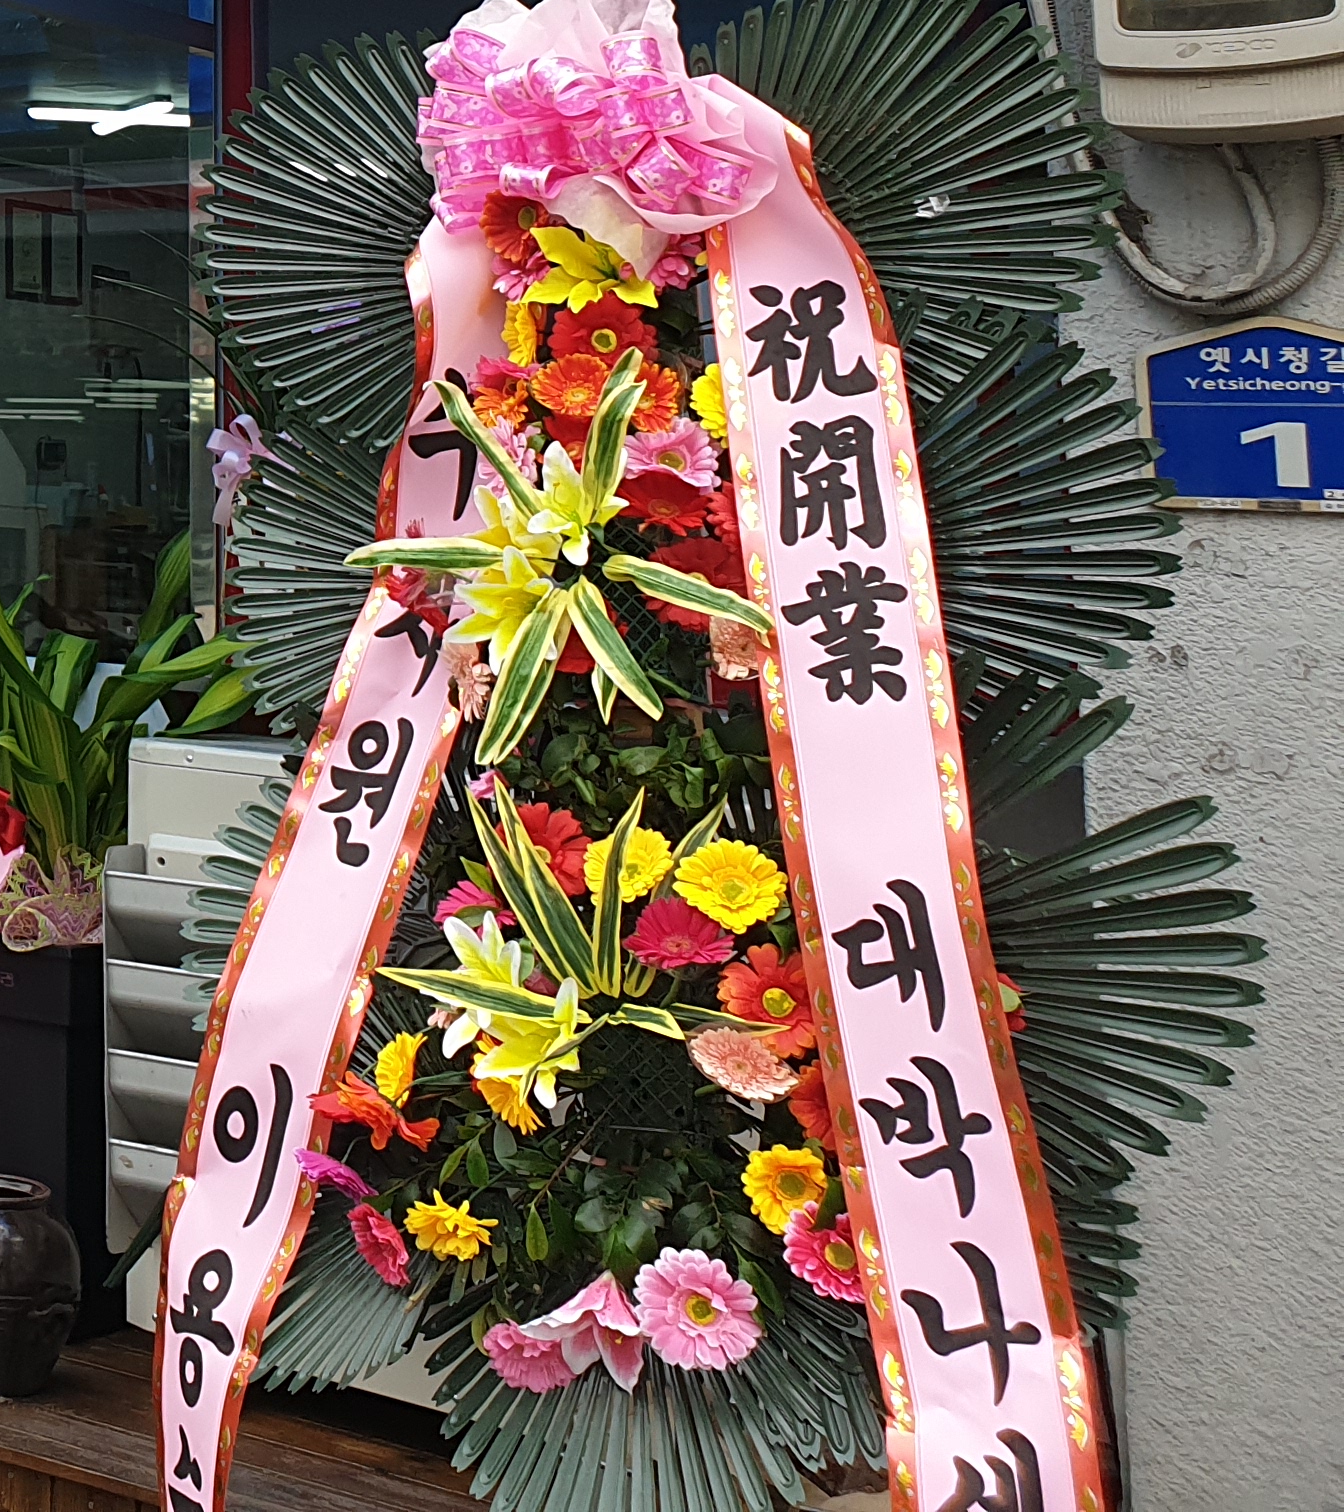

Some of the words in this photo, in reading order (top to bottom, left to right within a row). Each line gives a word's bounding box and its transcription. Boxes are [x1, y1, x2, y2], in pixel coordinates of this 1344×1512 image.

[1184, 376, 1344, 394] Yetsicheong-
[1240, 421, 1311, 488] 1
[745, 281, 909, 705] 祝開業
